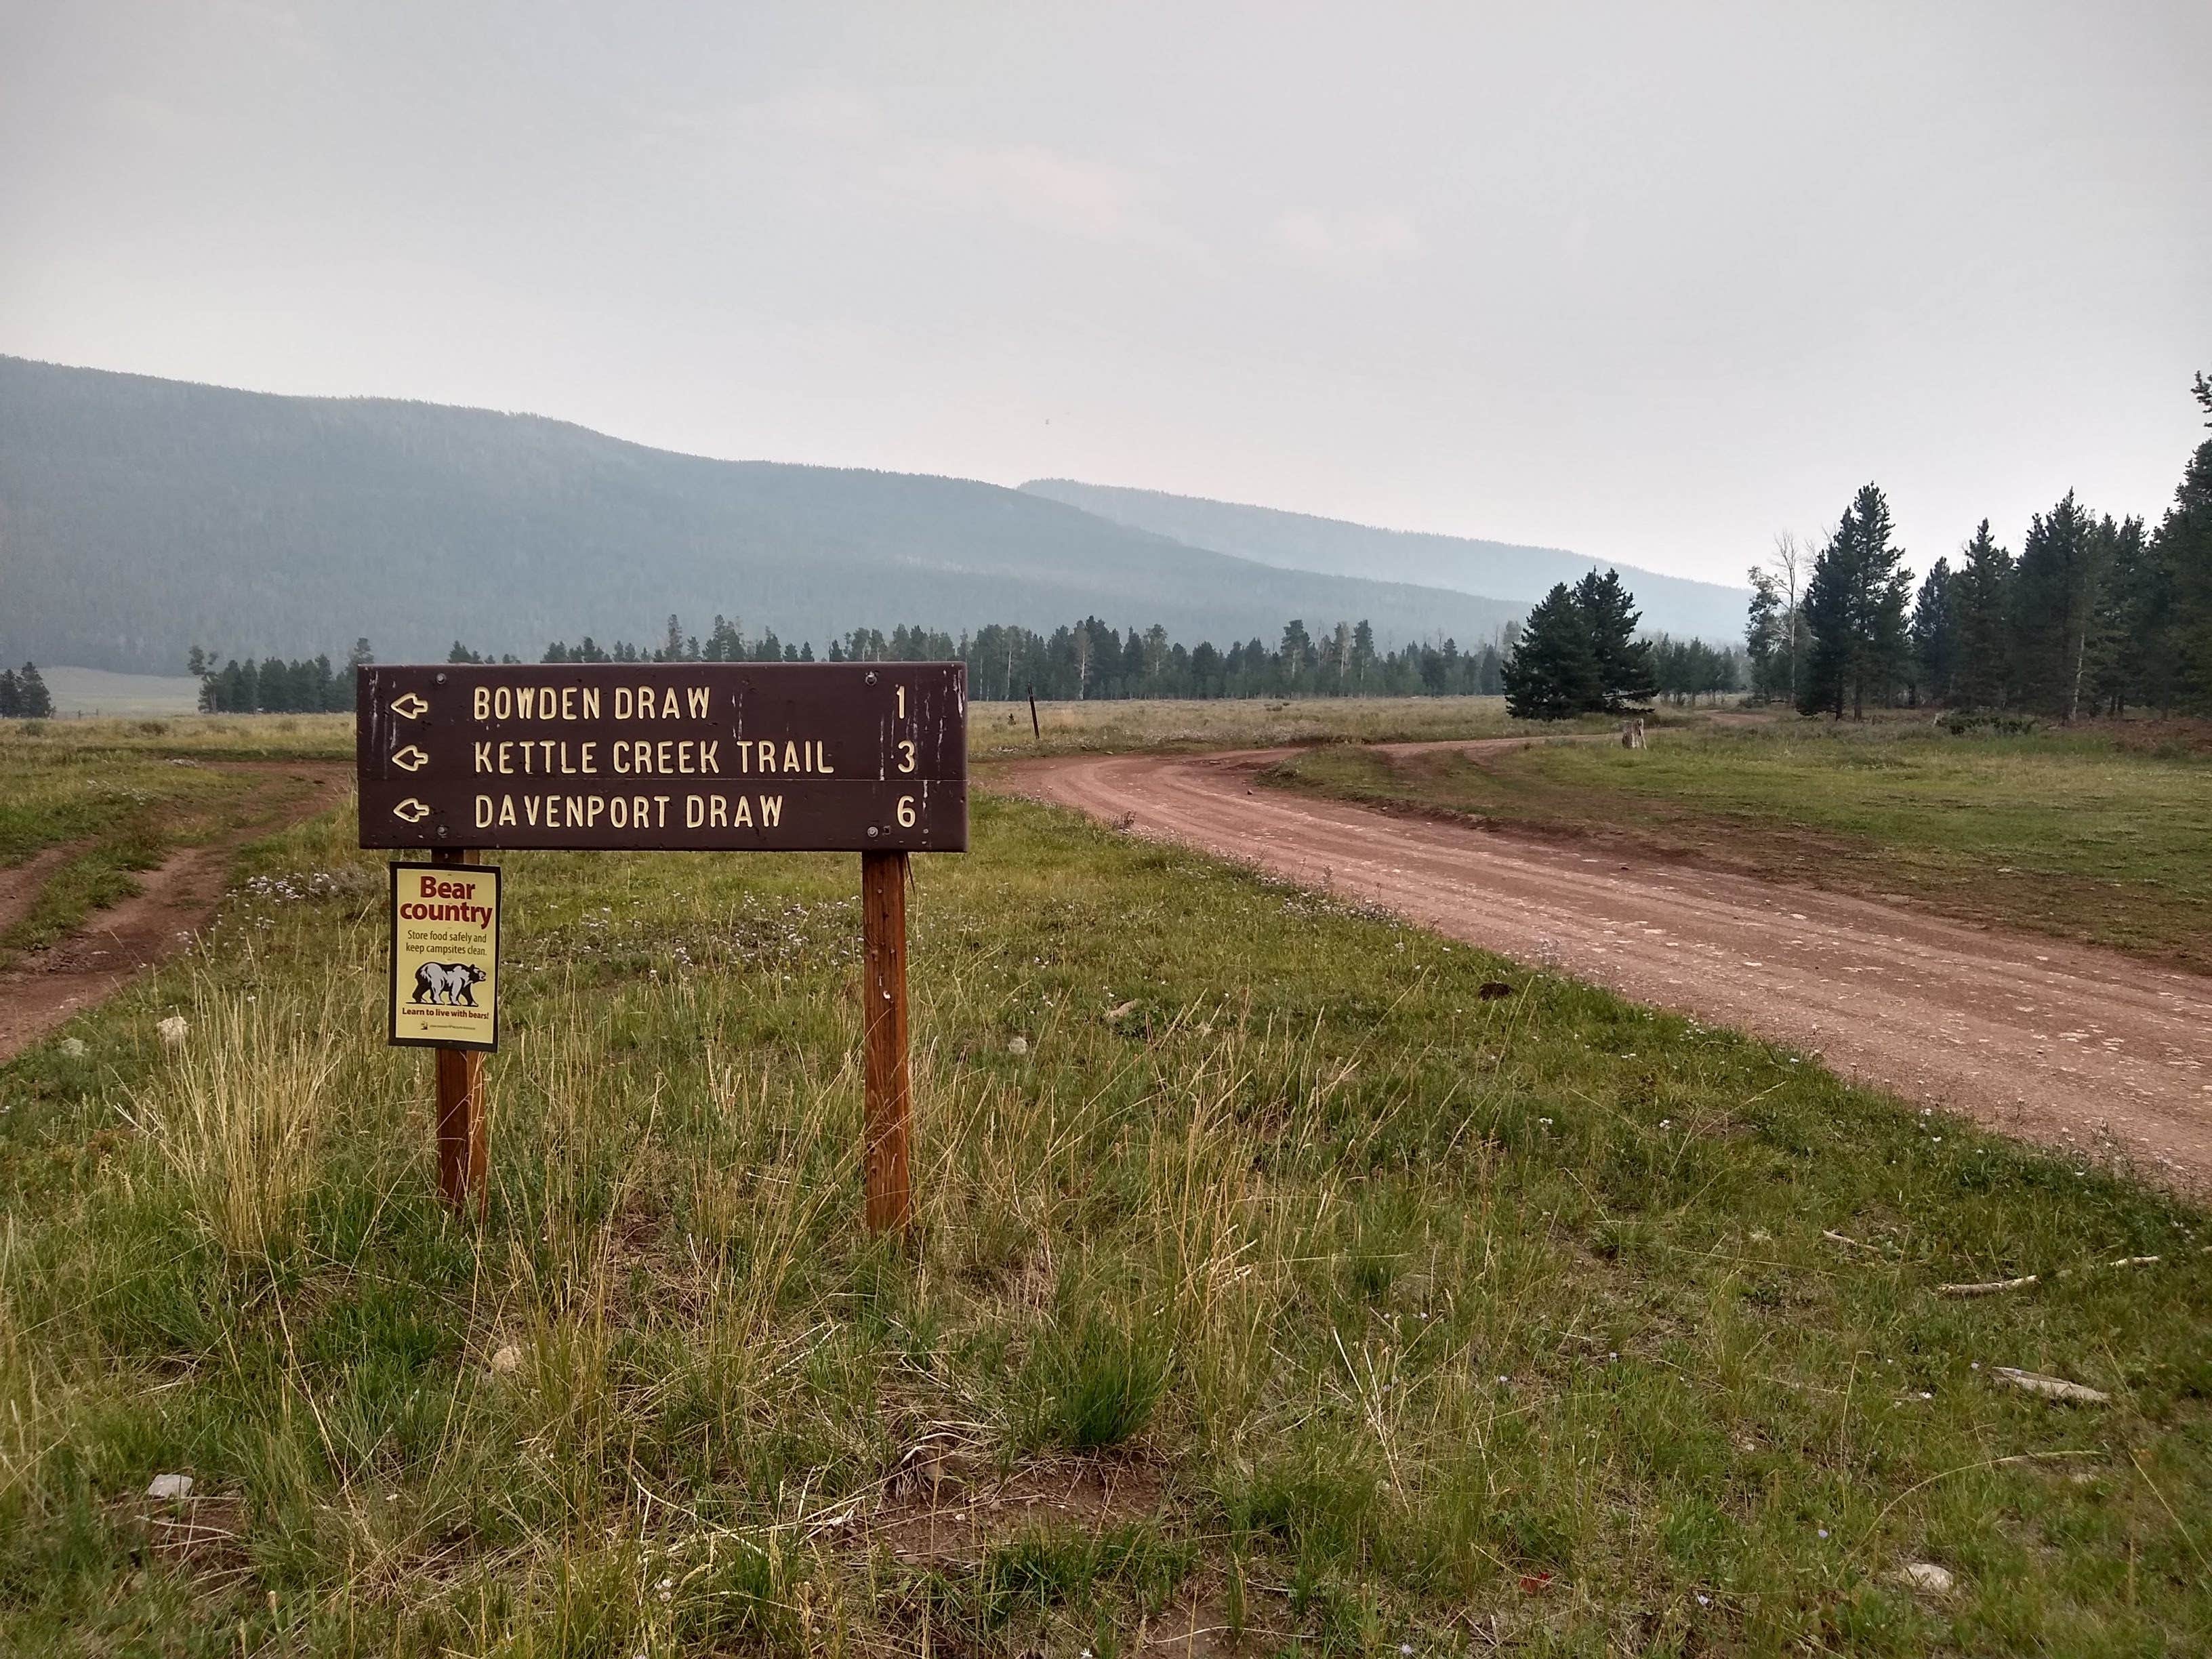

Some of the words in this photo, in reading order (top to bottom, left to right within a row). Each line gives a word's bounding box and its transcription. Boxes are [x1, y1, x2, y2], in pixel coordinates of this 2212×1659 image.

[474, 687, 600, 720] BOWDEN
[614, 687, 710, 720] DRAW
[895, 685, 907, 720] 1
[474, 741, 597, 774] KETTLE
[613, 740, 719, 774] CREEK
[736, 740, 834, 774] TRAIL
[897, 740, 916, 773] 3
[474, 794, 670, 829] DAVENPORT
[686, 794, 783, 829] DRAW
[896, 795, 916, 829] 6
[420, 876, 476, 900] Bear
[400, 901, 493, 929] country
[406, 943, 424, 954] keep
[426, 943, 466, 955] campsites
[468, 945, 487, 956] clean.
[407, 930, 428, 940] Store
[430, 930, 447, 941] food
[449, 932, 472, 943] safely
[473, 934, 487, 943] and
[402, 1008, 424, 1016] Learn
[436, 1008, 449, 1017] live
[451, 1009, 467, 1018] with
[468, 1010, 489, 1019] bears!
